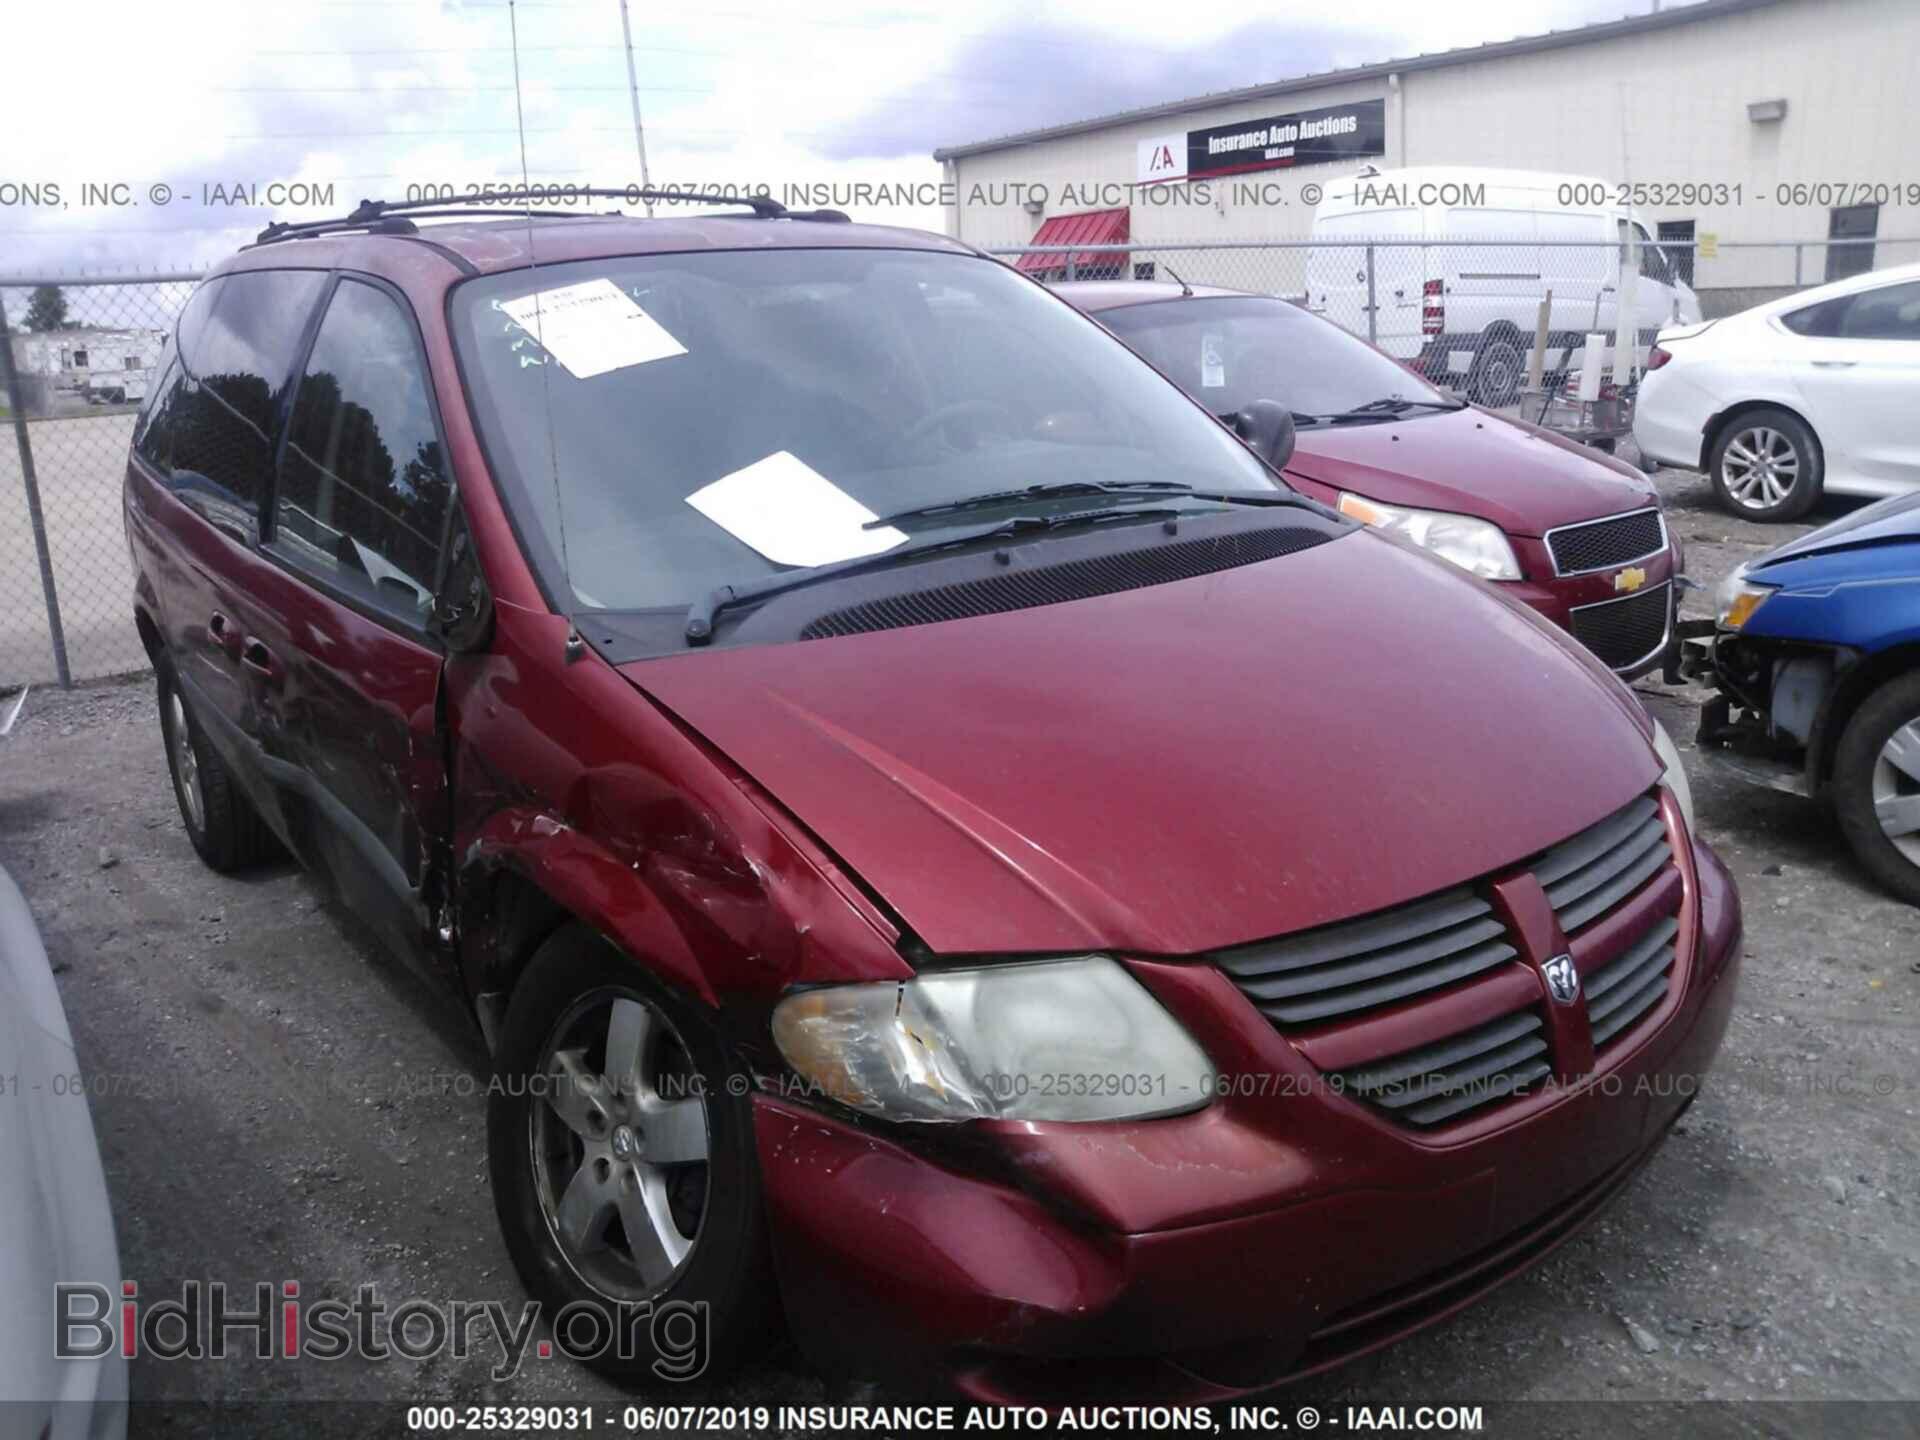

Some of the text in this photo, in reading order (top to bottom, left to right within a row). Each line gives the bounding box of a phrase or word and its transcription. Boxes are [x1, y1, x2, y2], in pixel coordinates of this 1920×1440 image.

[1208, 115, 1357, 155] Insurance Auto Auctions
